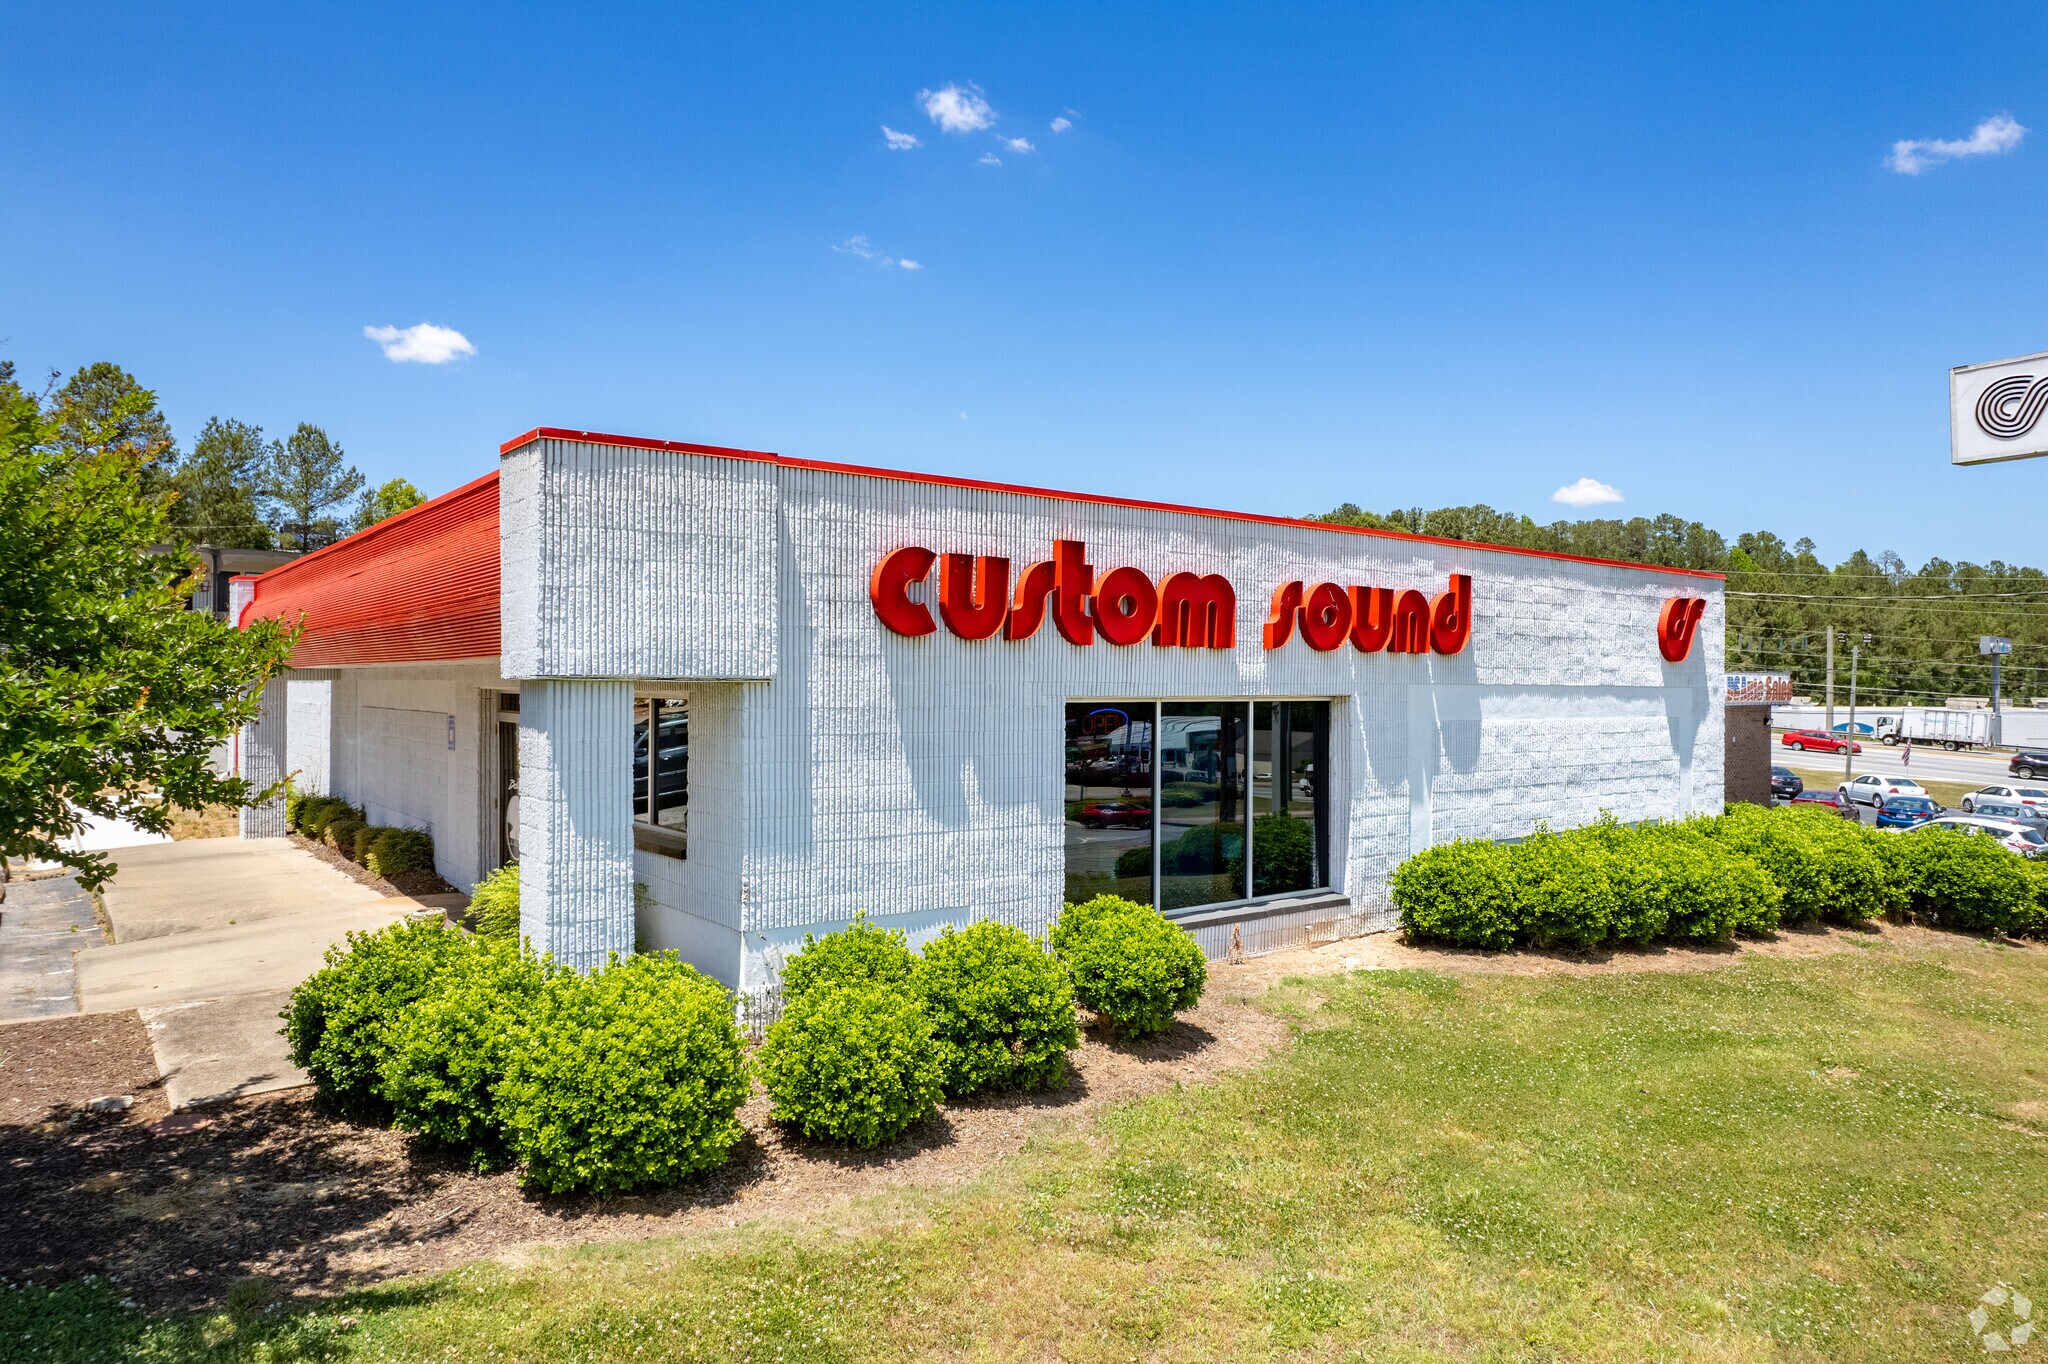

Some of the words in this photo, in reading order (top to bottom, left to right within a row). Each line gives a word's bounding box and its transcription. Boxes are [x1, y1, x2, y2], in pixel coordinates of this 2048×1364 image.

[869, 539, 1236, 649] custom
[1263, 574, 1472, 655] sound
[1766, 675, 1793, 701] Sales
